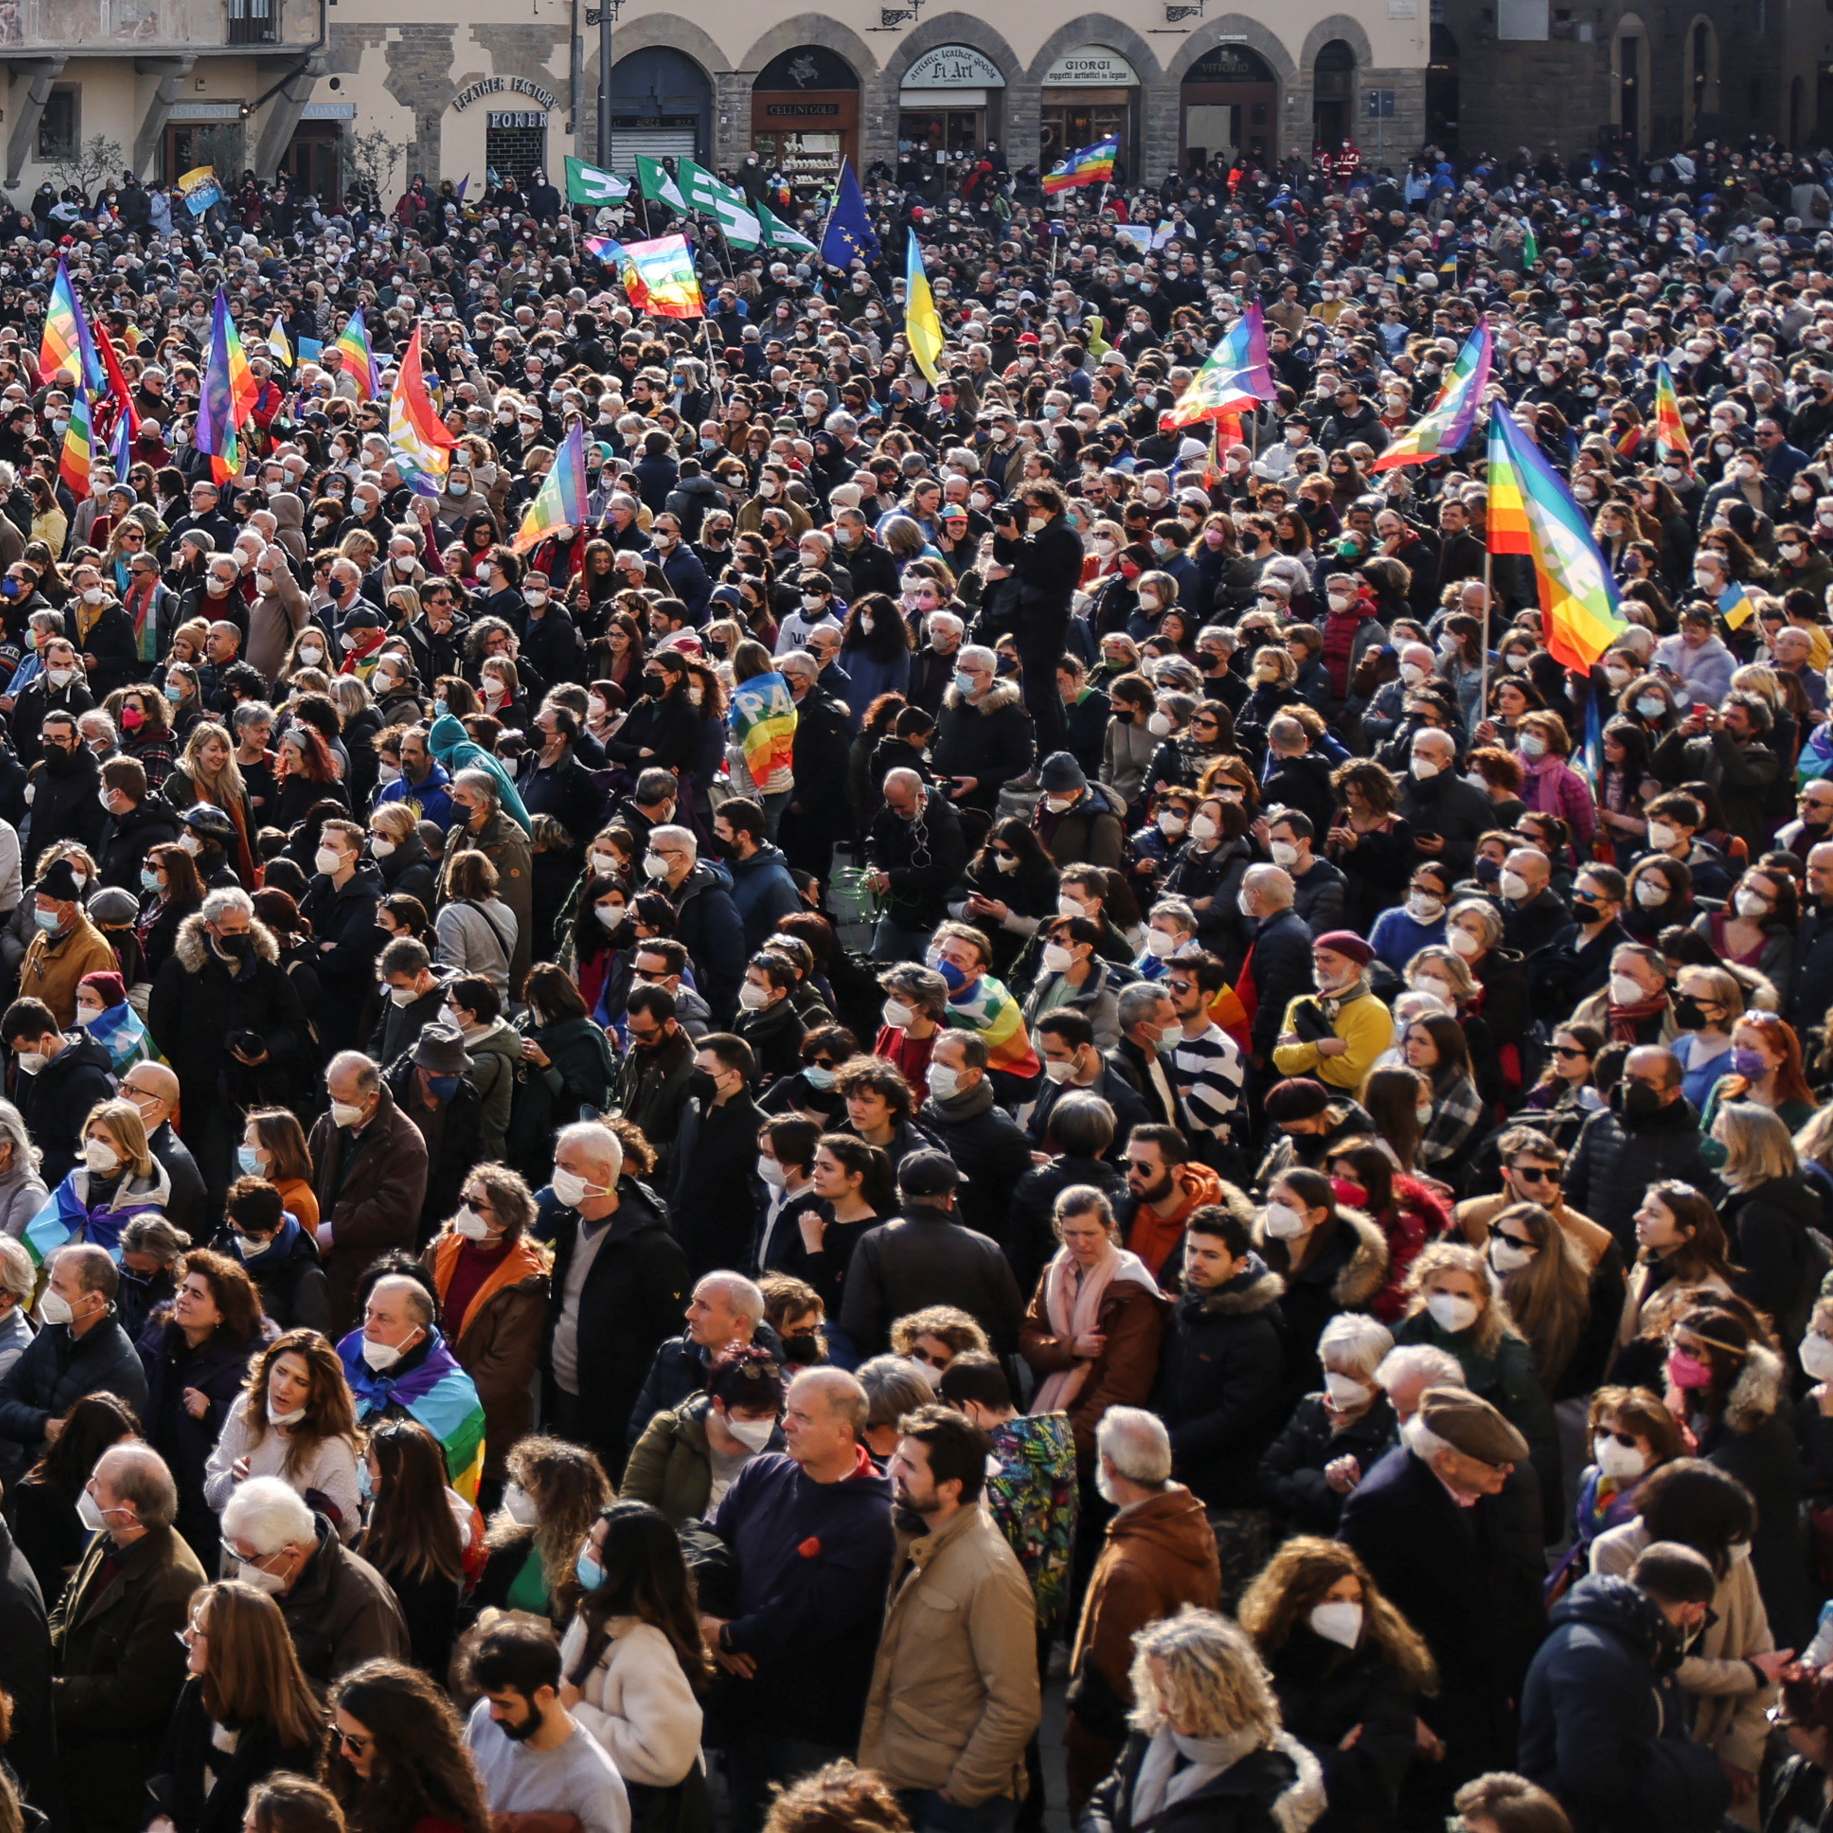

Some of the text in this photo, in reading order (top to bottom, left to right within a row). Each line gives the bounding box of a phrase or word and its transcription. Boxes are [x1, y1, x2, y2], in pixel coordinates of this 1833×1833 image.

[911, 49, 996, 80] artistic leather goods
[1065, 61, 1110, 70] GIORGI
[1202, 63, 1249, 73] VITTORIO
[453, 77, 559, 112] LEATHER FACTORY
[770, 105, 835, 115] CELLINI GOLD
[491, 112, 549, 128] POKER
[49, 295, 81, 352] PAC
[1538, 522, 1603, 600] CE
[735, 684, 793, 725] PA
